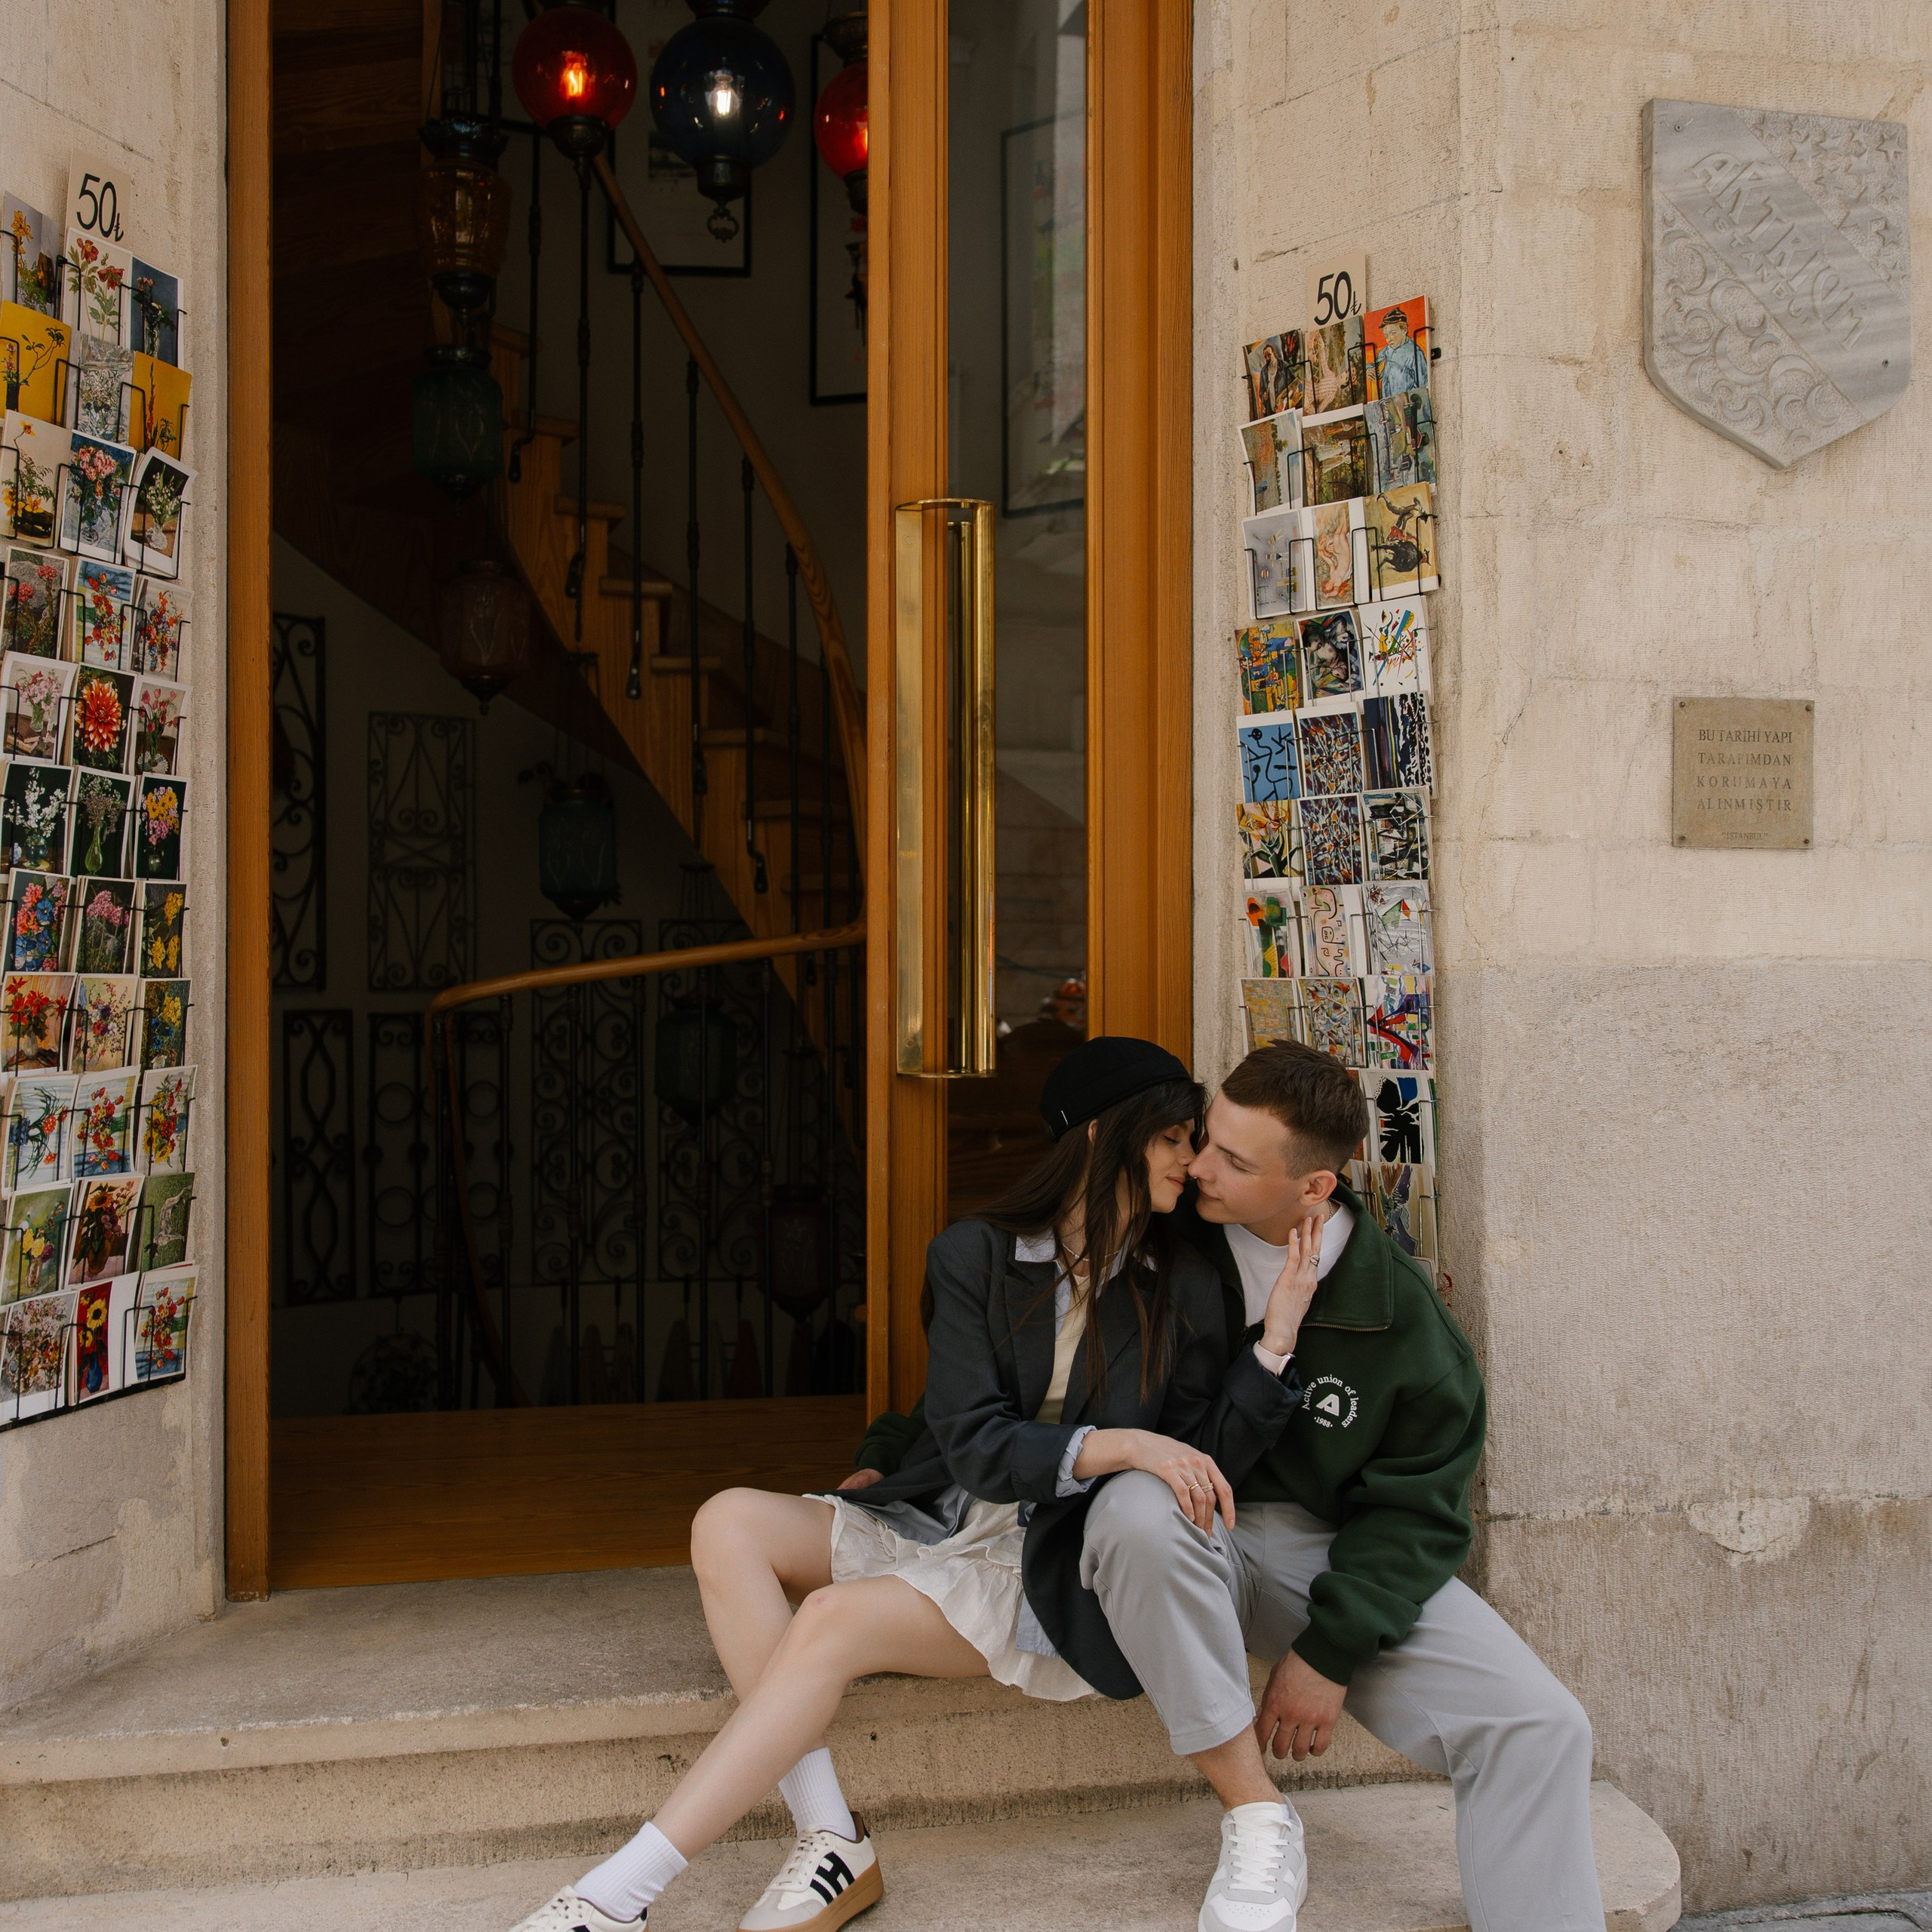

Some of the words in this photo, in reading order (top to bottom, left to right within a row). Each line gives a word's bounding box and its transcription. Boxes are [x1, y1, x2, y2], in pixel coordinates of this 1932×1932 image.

[1698, 729, 1715, 741] BU
[1718, 728, 1761, 743] TARİHİ
[1764, 731, 1793, 744] YAPI
[1698, 752, 1792, 766] TARAFIMDAN
[1696, 775, 1792, 789] KORUMAYA
[1697, 798, 1792, 814] ALINMIŞTIR
[1316, 1374, 1343, 1387] union
[1302, 1382, 1317, 1411] Active
[1344, 1386, 1356, 1396] of
[1341, 1397, 1359, 1428] leaders
